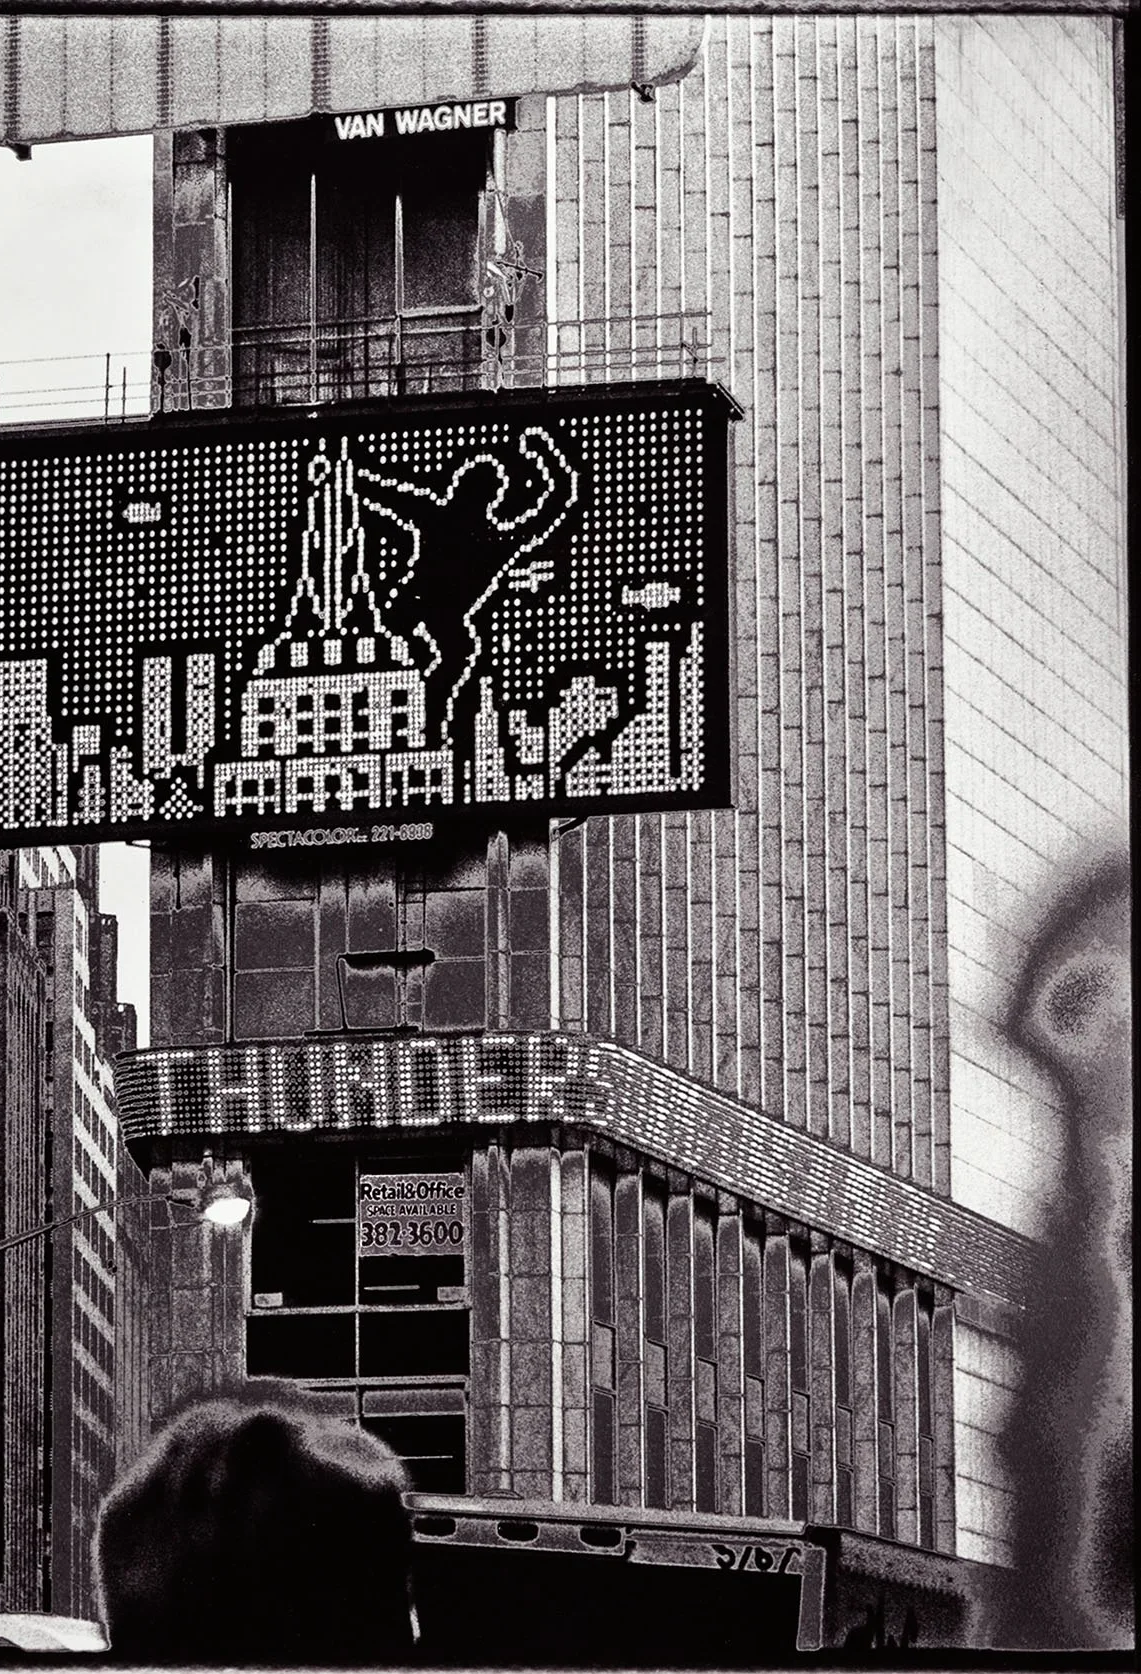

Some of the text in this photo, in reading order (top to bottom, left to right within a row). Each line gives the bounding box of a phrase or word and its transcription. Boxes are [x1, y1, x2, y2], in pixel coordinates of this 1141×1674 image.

[334, 101, 506, 140] VAN WAGNER
[360, 1182, 465, 1200] Retail&Office
[367, 1204, 456, 1217] SPACE AVAILABLE
